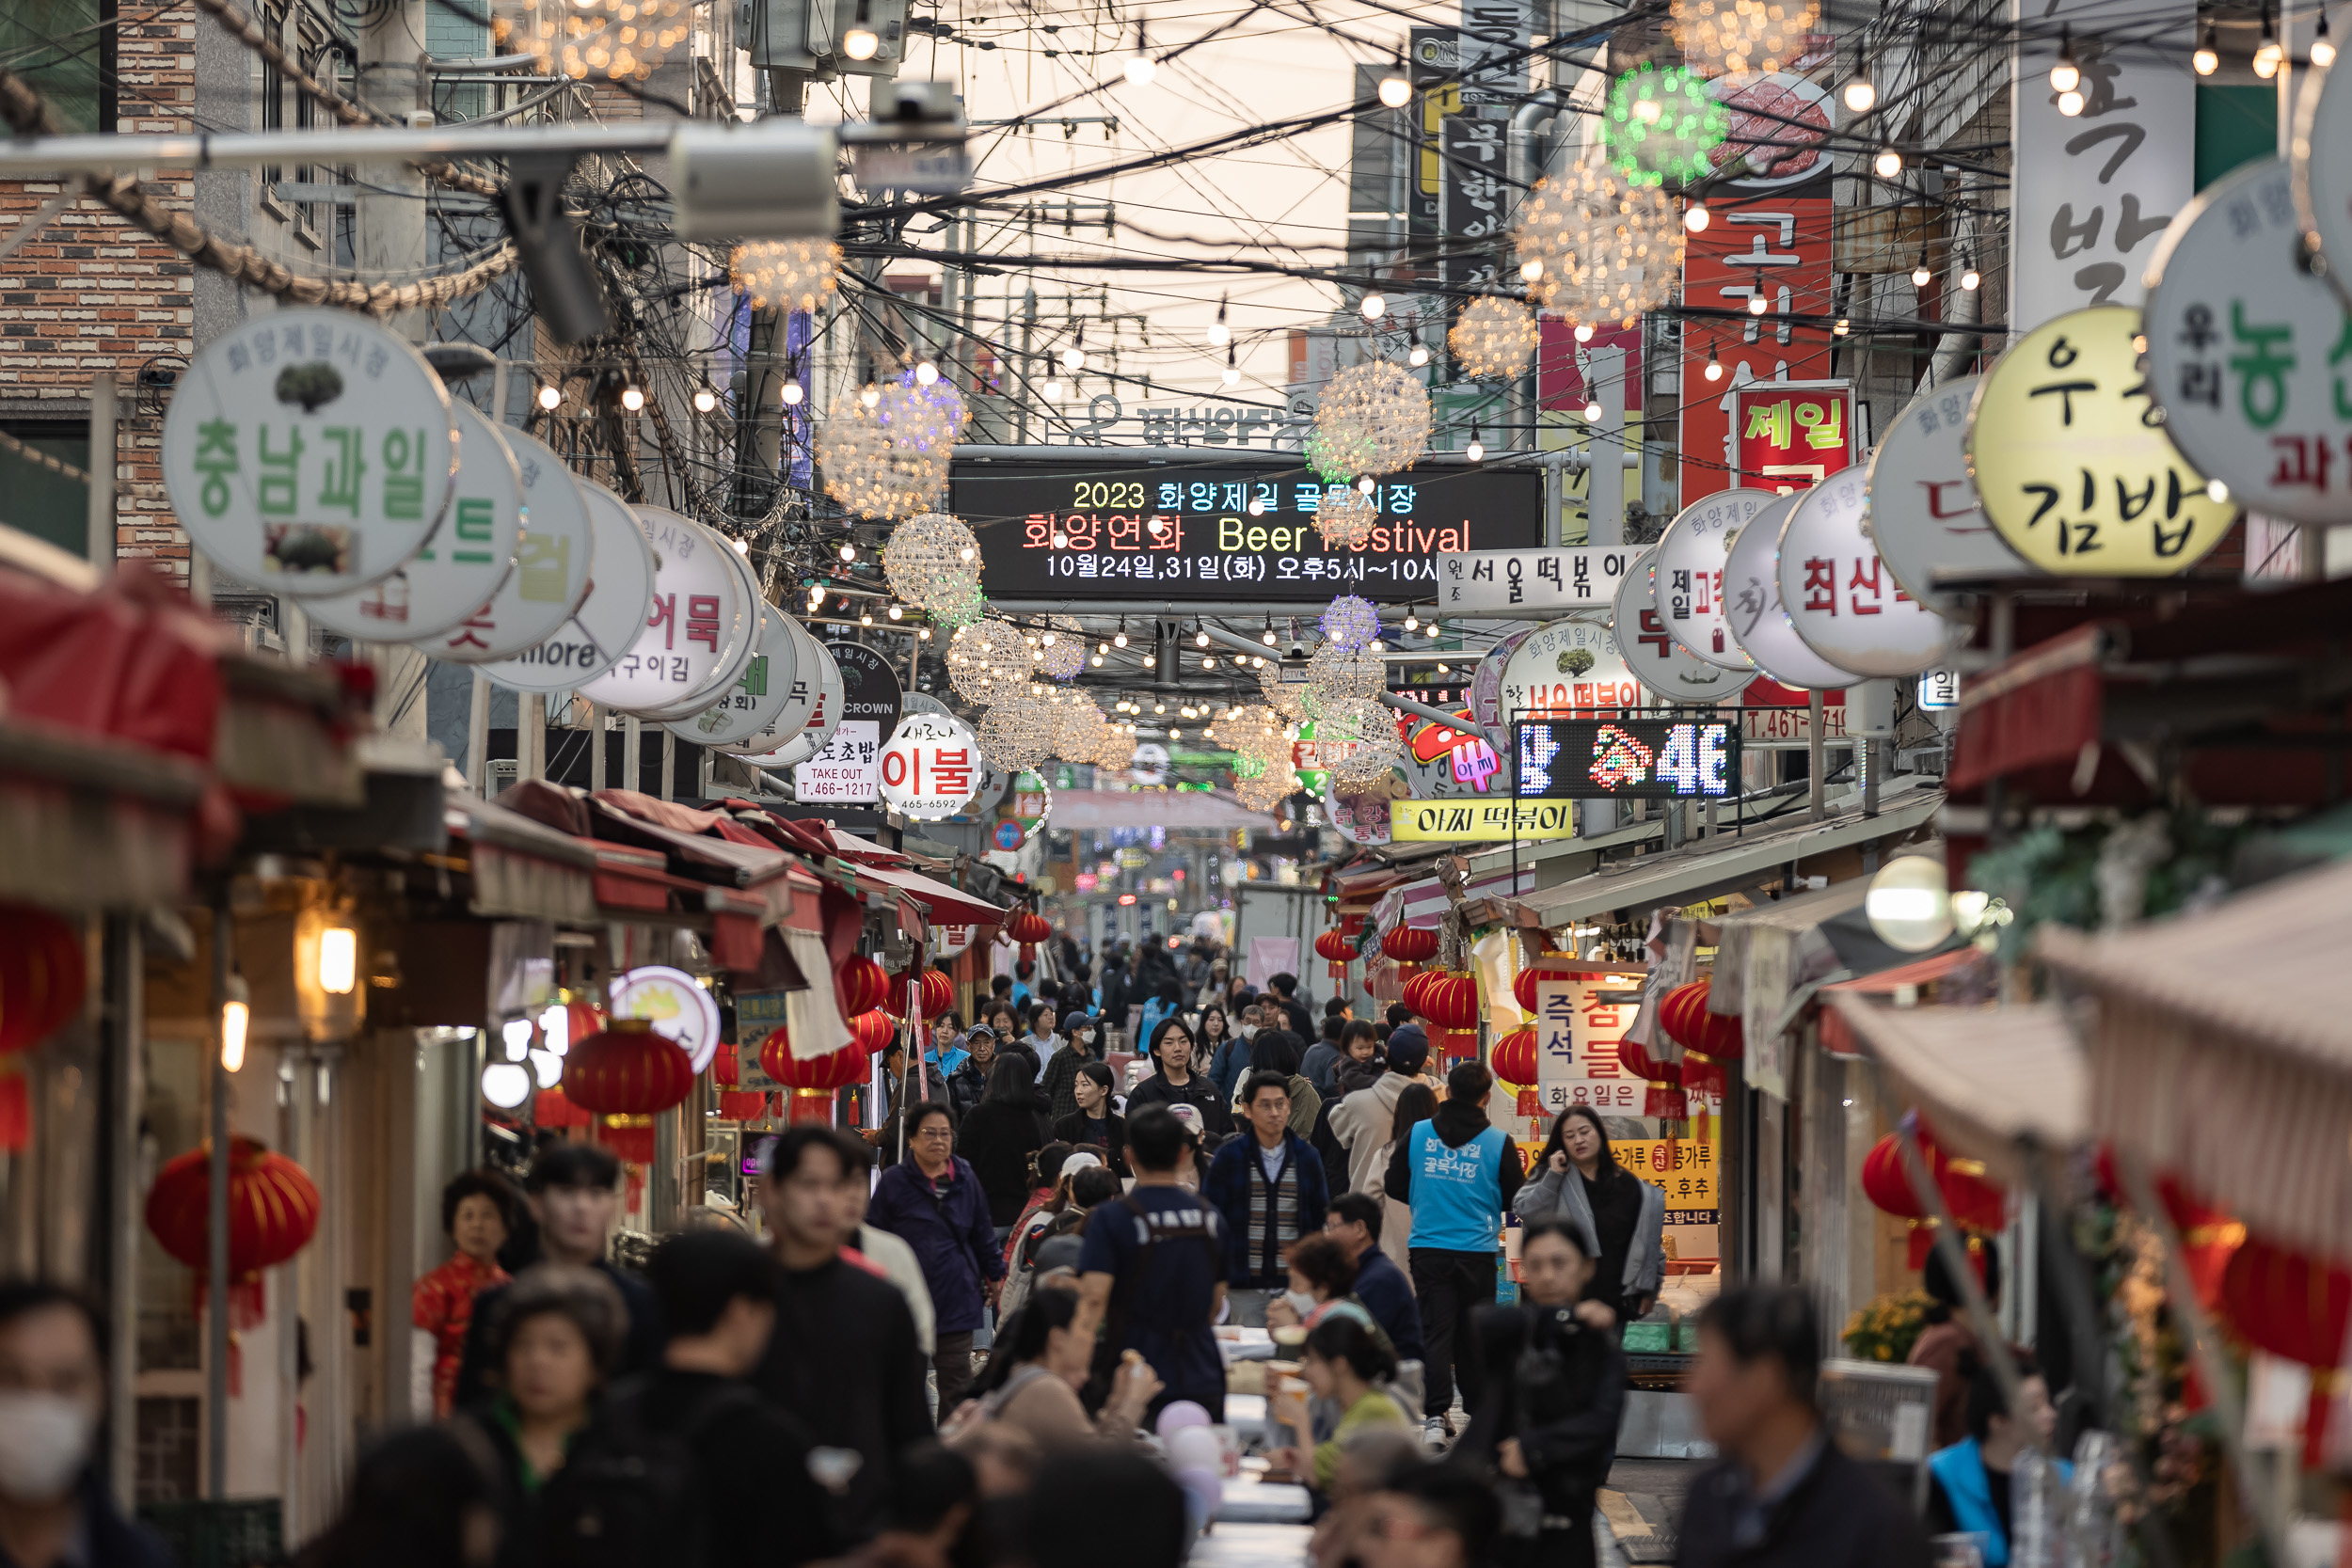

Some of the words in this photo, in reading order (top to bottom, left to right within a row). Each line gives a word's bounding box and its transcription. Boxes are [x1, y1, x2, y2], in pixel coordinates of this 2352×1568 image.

[2044, 0, 2173, 308] 족발
[1744, 398, 1844, 451] 제일
[194, 417, 428, 520] 충남과일
[1073, 482, 1146, 509] 2023
[1157, 482, 1279, 514] 화양제일
[2022, 467, 2210, 558] 김밥
[643, 517, 695, 561] 일시장
[1023, 513, 1186, 553] 화양연화
[1218, 516, 1309, 553] Beer
[1322, 518, 1470, 554] Festival
[1047, 553, 1266, 582] 10월24일,31일(화)
[1448, 558, 1465, 602] 원조
[1470, 552, 1627, 605] 서울떡볶이
[1671, 568, 1692, 621] 제일
[647, 592, 721, 654] 어묵
[610, 654, 690, 683] 구이김
[900, 722, 957, 741] 새로나
[805, 738, 876, 765] 도초밥
[802, 783, 872, 796] T.466-1217
[811, 768, 838, 780] TAKE
[841, 768, 863, 780] OUT
[882, 748, 974, 796] 이불
[901, 800, 957, 809] 465-6592
[1417, 806, 1474, 833] 아찌
[1483, 805, 1568, 832] 떡볶이
[1545, 993, 1574, 1065] 즉석
[1550, 1084, 1635, 1109] 화요일은
[1612, 1147, 1646, 1171] 수가루
[1662, 1212, 1711, 1224] 조합니다
